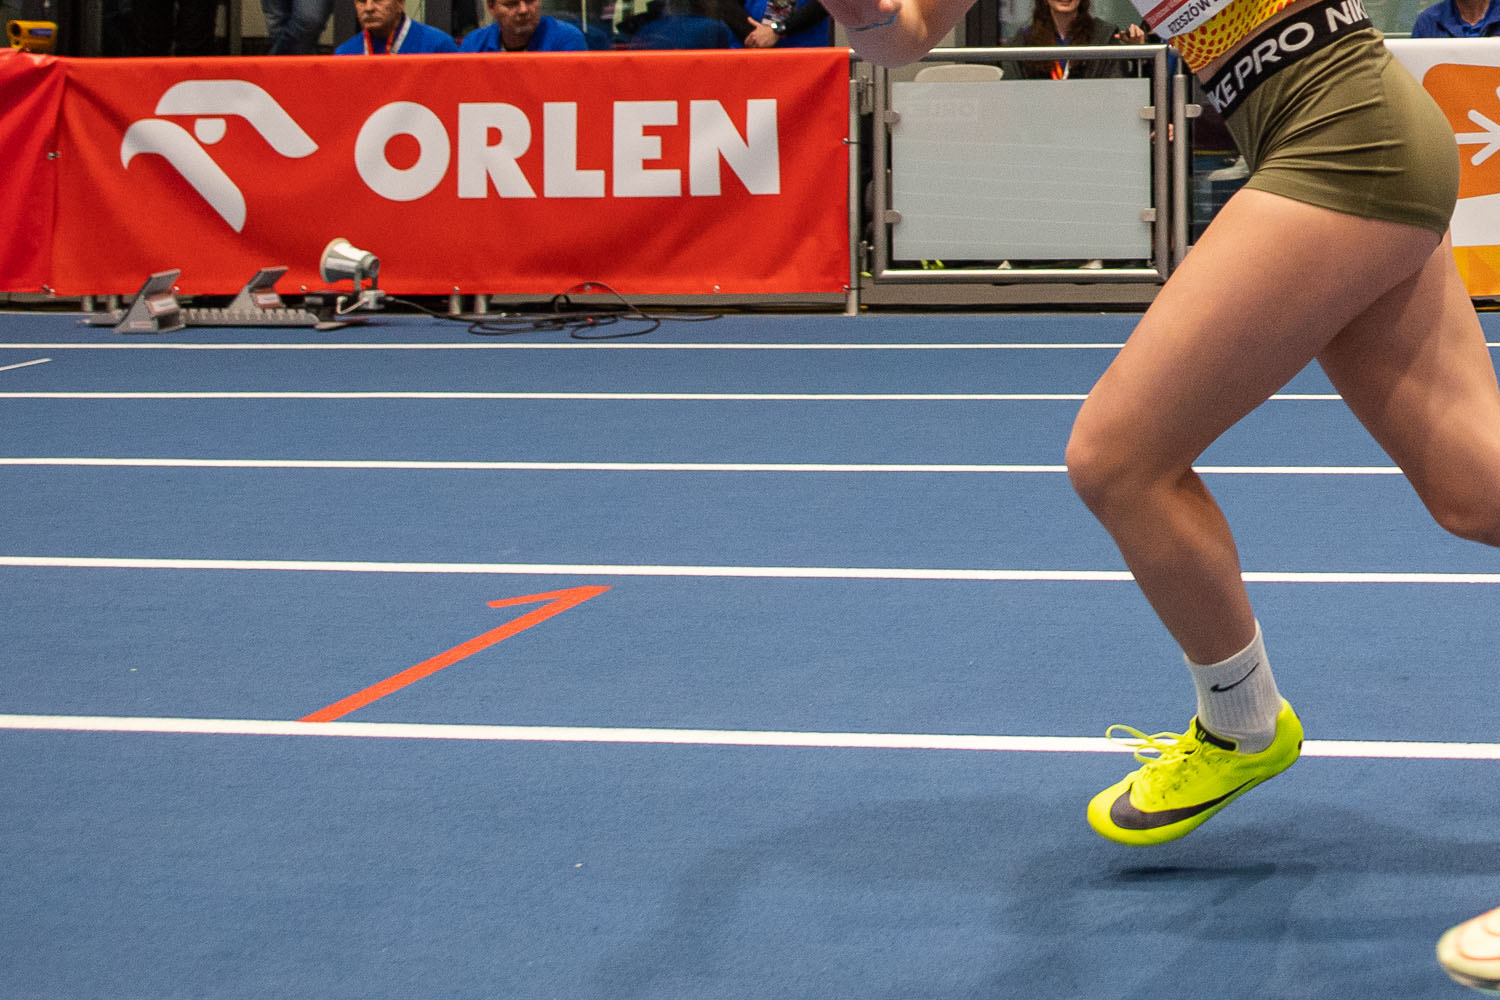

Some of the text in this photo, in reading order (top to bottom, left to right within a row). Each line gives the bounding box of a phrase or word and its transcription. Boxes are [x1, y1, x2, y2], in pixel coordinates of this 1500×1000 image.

[1207, 72, 1238, 114] KE
[1234, 21, 1315, 90] PRO
[354, 98, 781, 202] ORLEN
